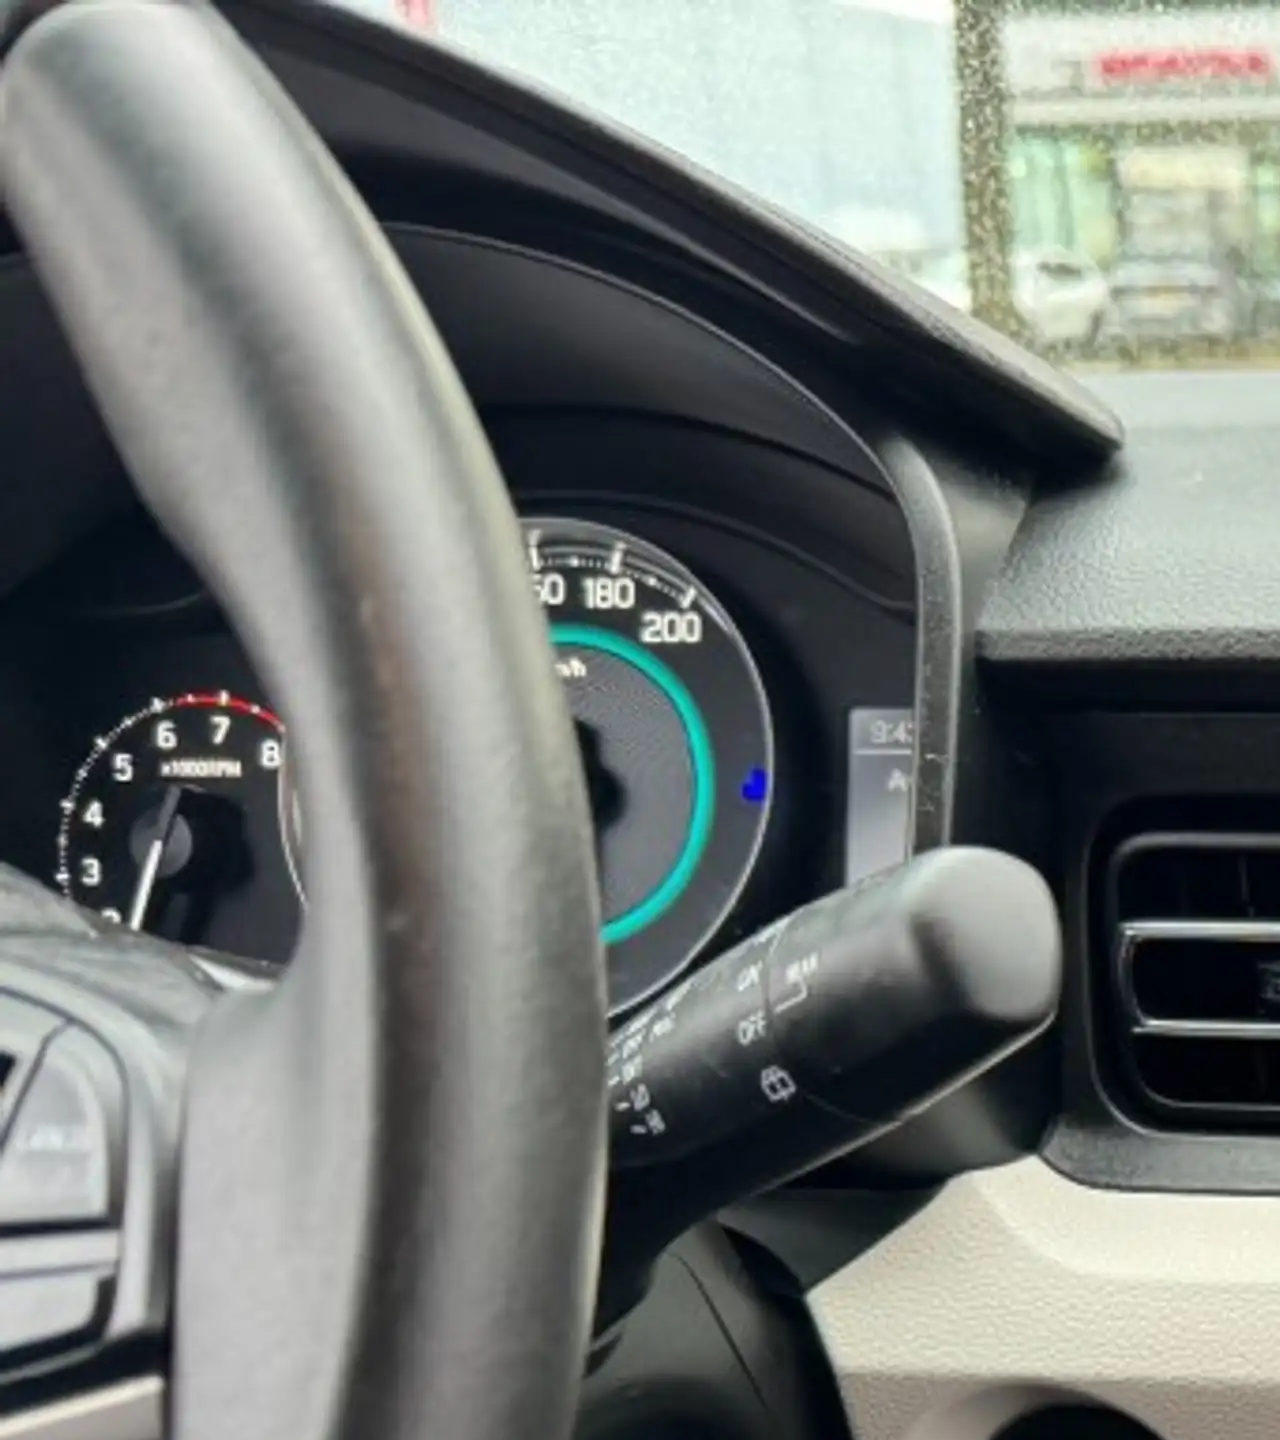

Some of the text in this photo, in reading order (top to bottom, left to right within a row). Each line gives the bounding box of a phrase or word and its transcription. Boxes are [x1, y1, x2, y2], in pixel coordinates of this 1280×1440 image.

[582, 576, 636, 609] 180
[641, 612, 702, 643] 200
[157, 721, 178, 749] 6
[209, 716, 231, 745] 7
[112, 753, 133, 781] 5
[260, 740, 282, 768] 8
[82, 800, 106, 827] 4
[81, 858, 102, 886] 3
